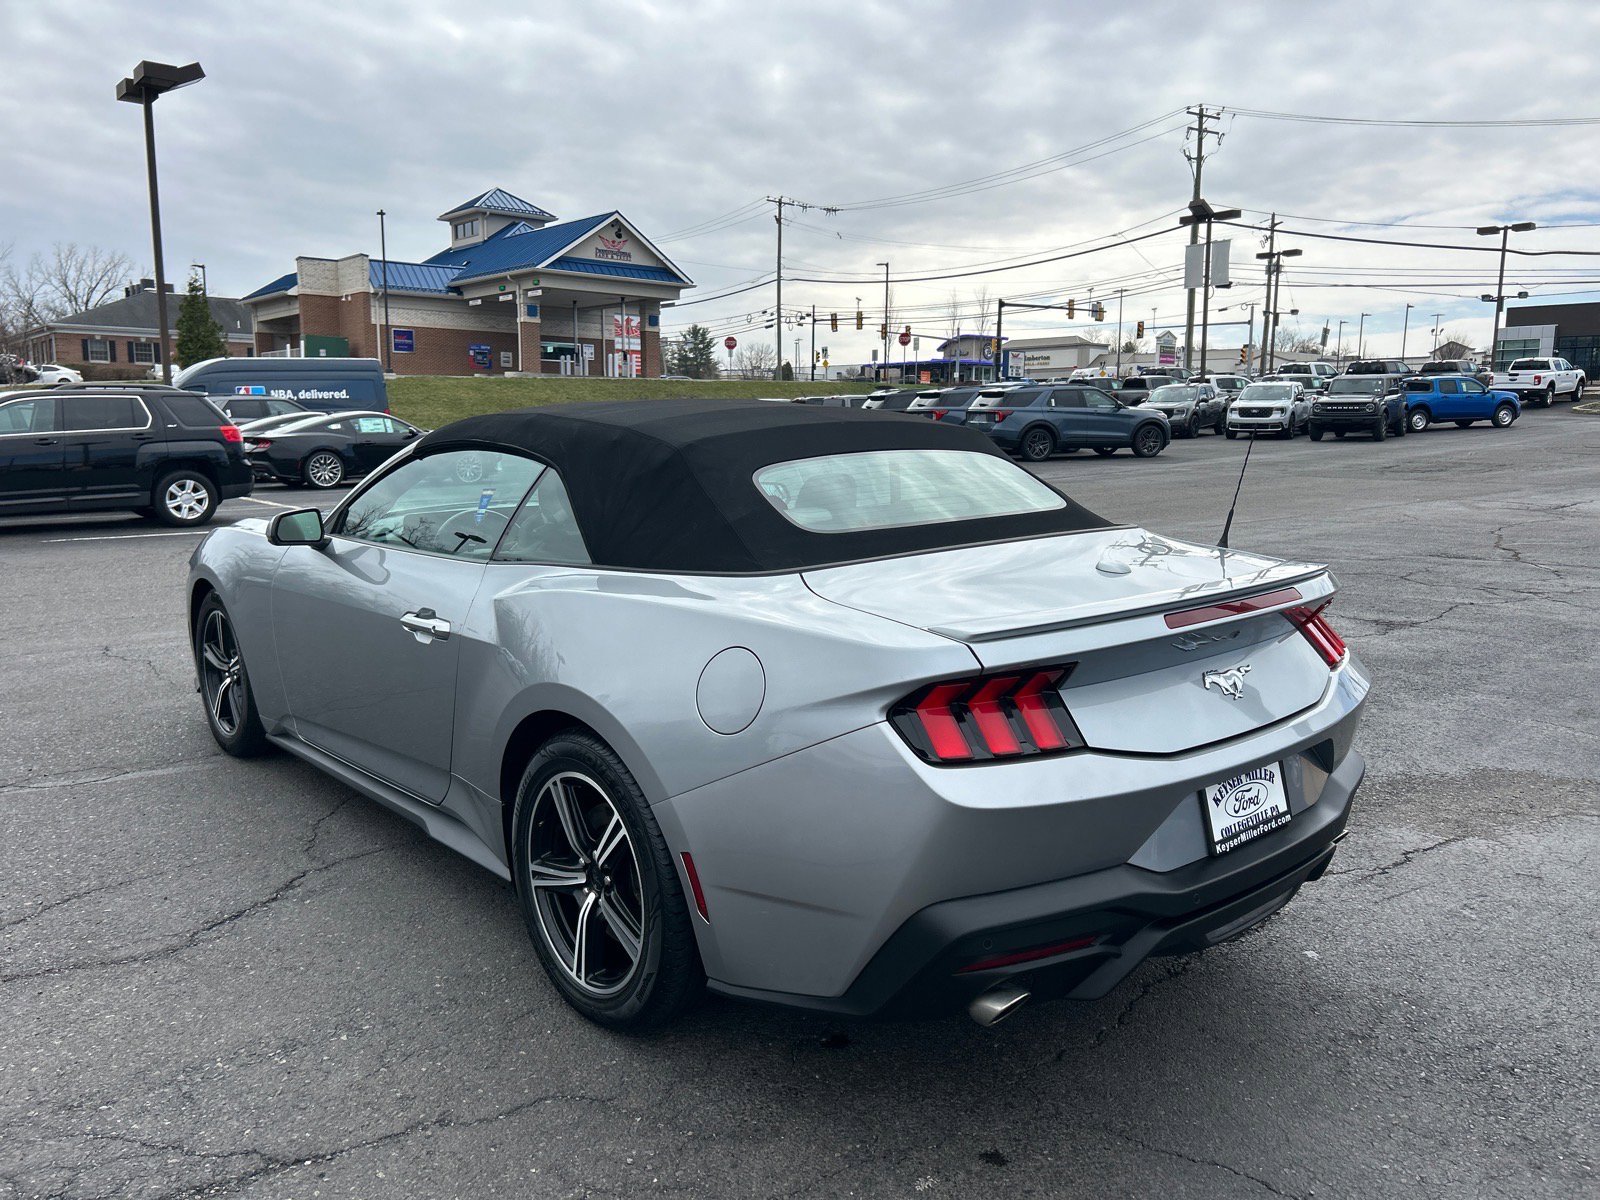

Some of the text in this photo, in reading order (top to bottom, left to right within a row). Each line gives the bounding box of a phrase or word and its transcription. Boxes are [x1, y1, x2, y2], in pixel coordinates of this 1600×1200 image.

[270, 389, 350, 401] NBA, delivered.
[1212, 767, 1275, 808] KEYSER MILLER
[1233, 786, 1262, 814] Ford
[1215, 814, 1291, 854] KeyserMillerFord.com
